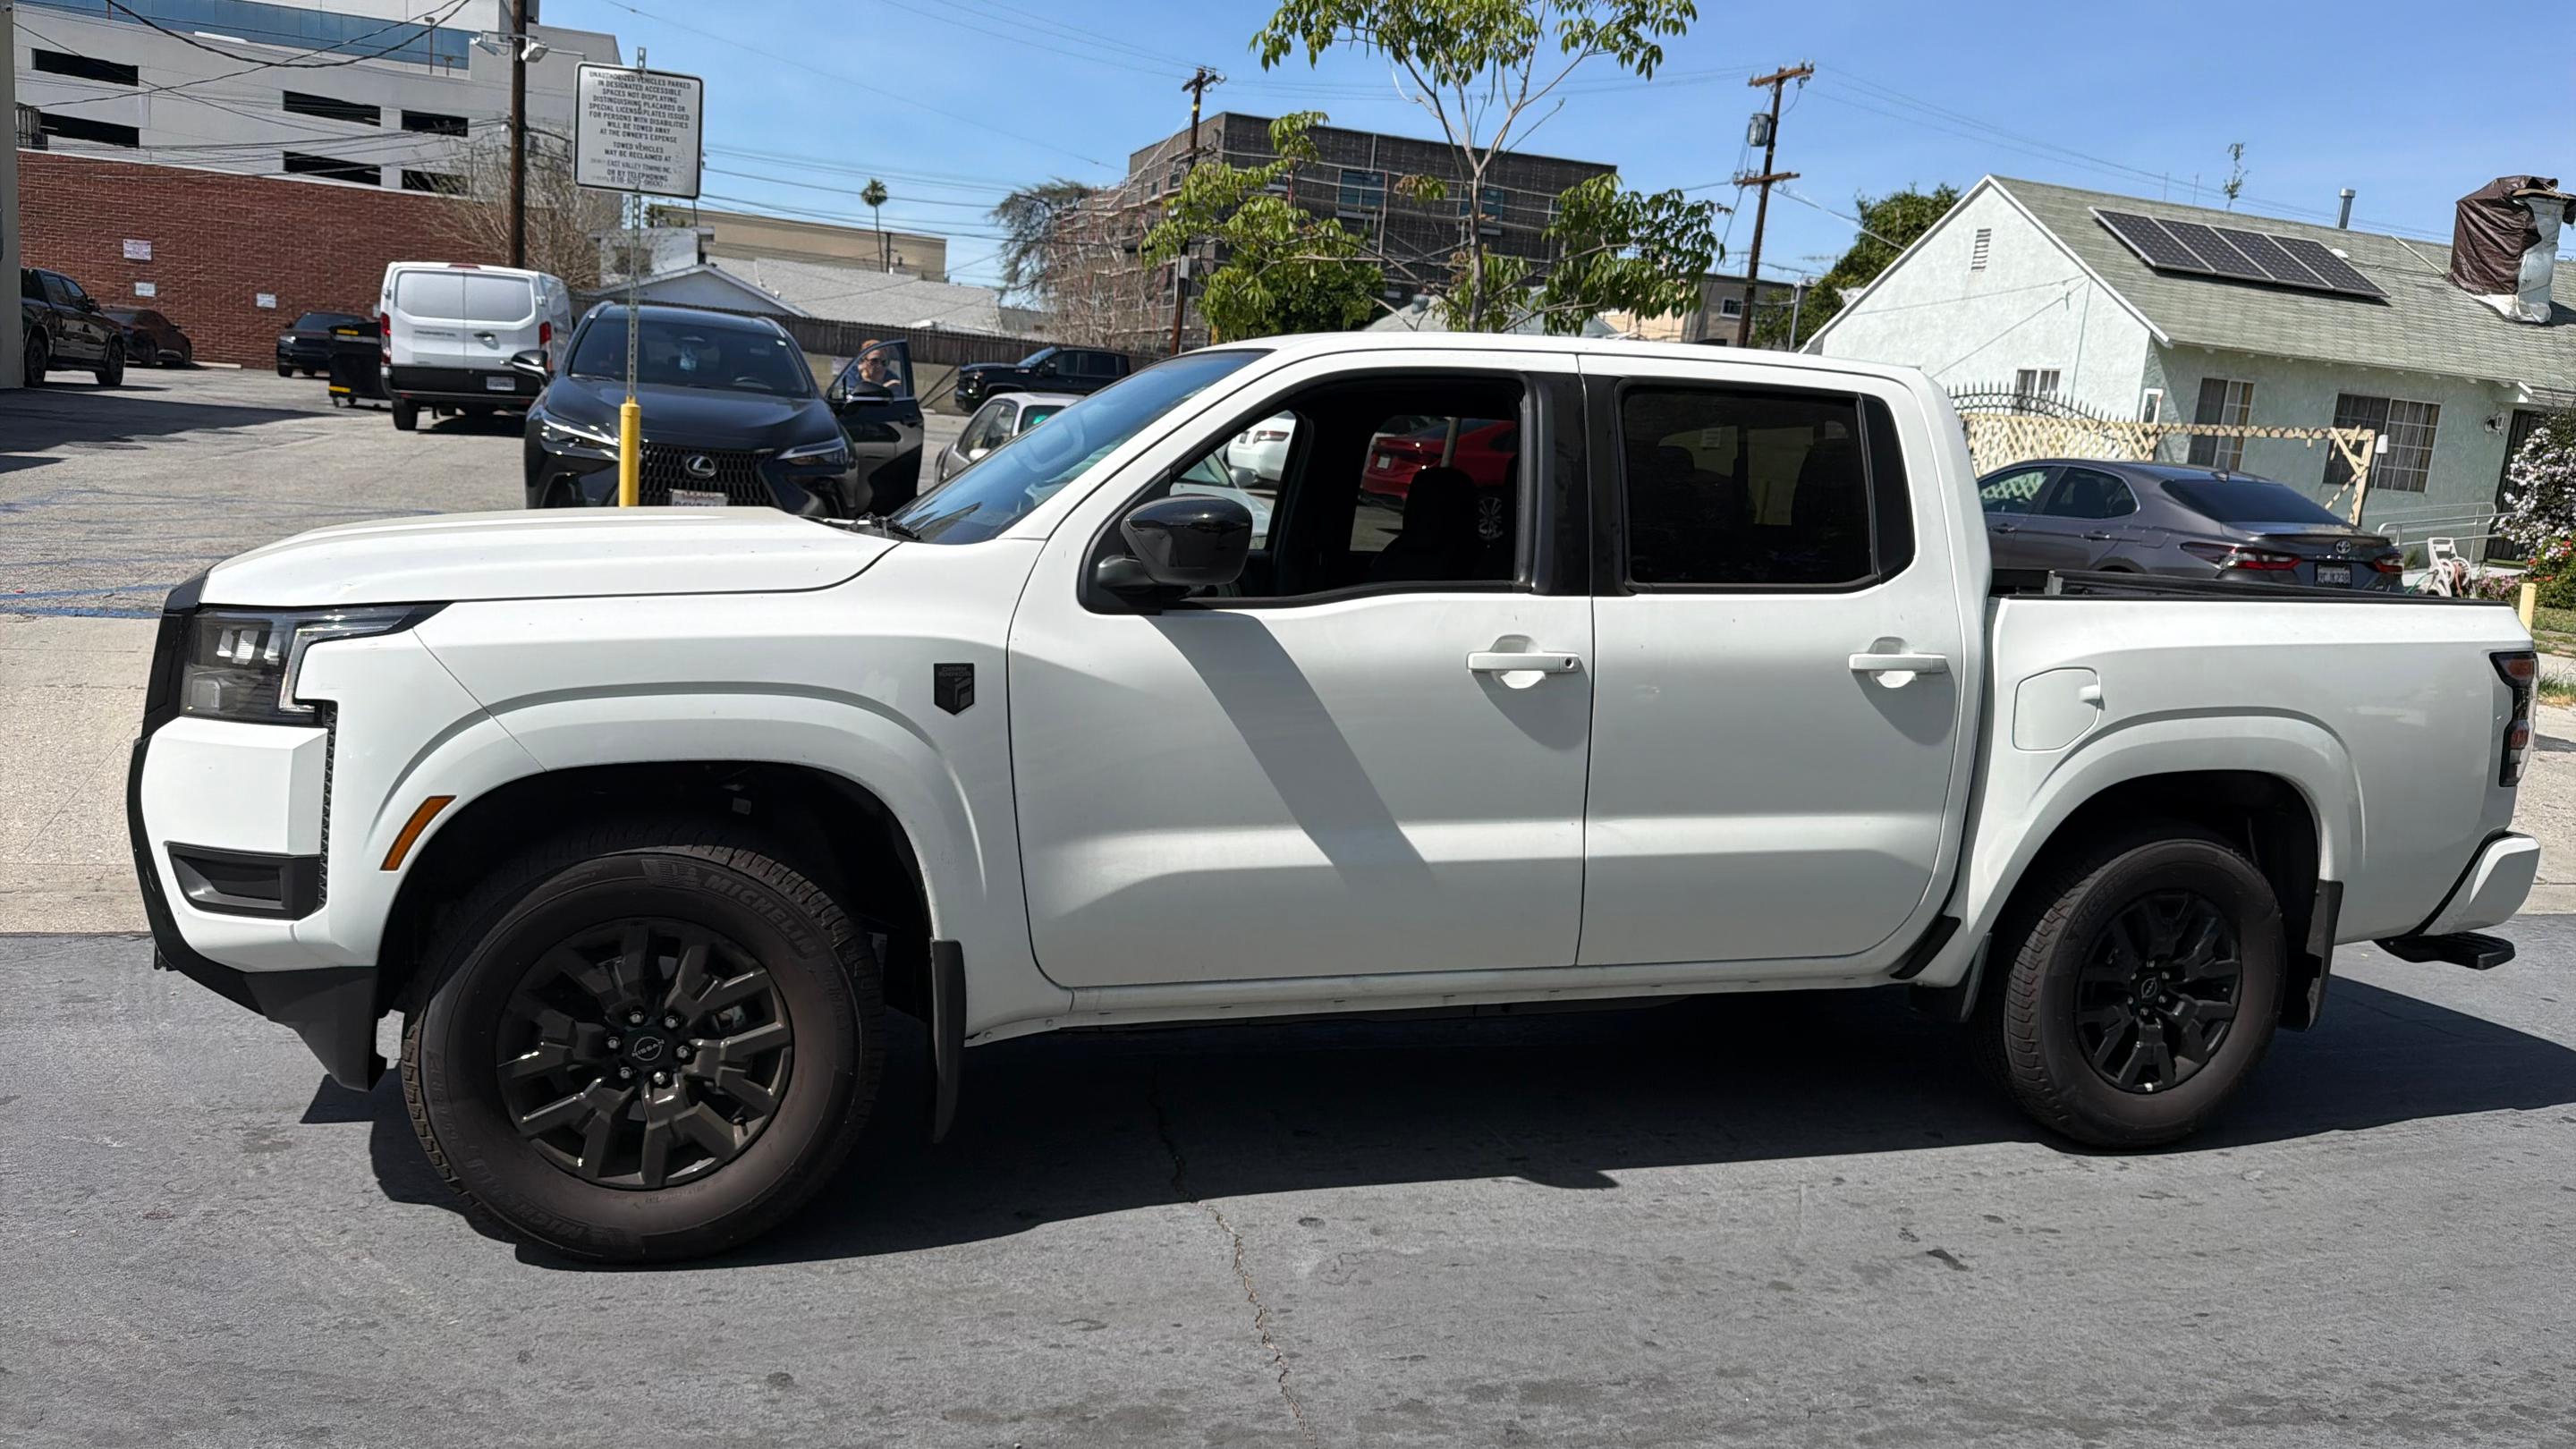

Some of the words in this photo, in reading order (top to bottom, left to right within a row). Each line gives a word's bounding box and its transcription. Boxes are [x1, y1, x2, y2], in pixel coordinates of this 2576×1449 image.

[589, 72, 635, 82] UNAUTHORIZED
[637, 76, 666, 87] VEHICLES
[667, 80, 691, 89] PARKED
[606, 80, 644, 91] DESIGNATED
[645, 86, 682, 97] ACCESSIBLE
[593, 95, 641, 106] DISTINGUISHING
[643, 101, 675, 112] PLACARDS
[603, 88, 626, 97] SPACES
[628, 90, 640, 98] NOT
[641, 92, 678, 104] DISPLAYING
[589, 102, 614, 112] SPECIAL
[643, 109, 666, 118] PLATES
[667, 113, 690, 121] ISSUED
[589, 110, 601, 118] FOR
[603, 112, 631, 122] PERSONS
[633, 115, 648, 123] WITH
[649, 117, 689, 129] DISABILITIES
[609, 129, 620, 137] THE
[622, 131, 648, 140] OWNER'S
[649, 134, 677, 144] EXPENSE
[632, 123, 653, 132] TOWED
[655, 126, 671, 135] AWAY
[605, 148, 617, 157] MAY
[629, 150, 663, 161] RECLAIMED
[613, 141, 633, 150] TOWED
[635, 143, 664, 154] VEHICLES
[627, 170, 668, 182] TELEPHONING
[704, 875, 818, 960] MICHELIN
[631, 1038, 665, 1057] NISSAN
